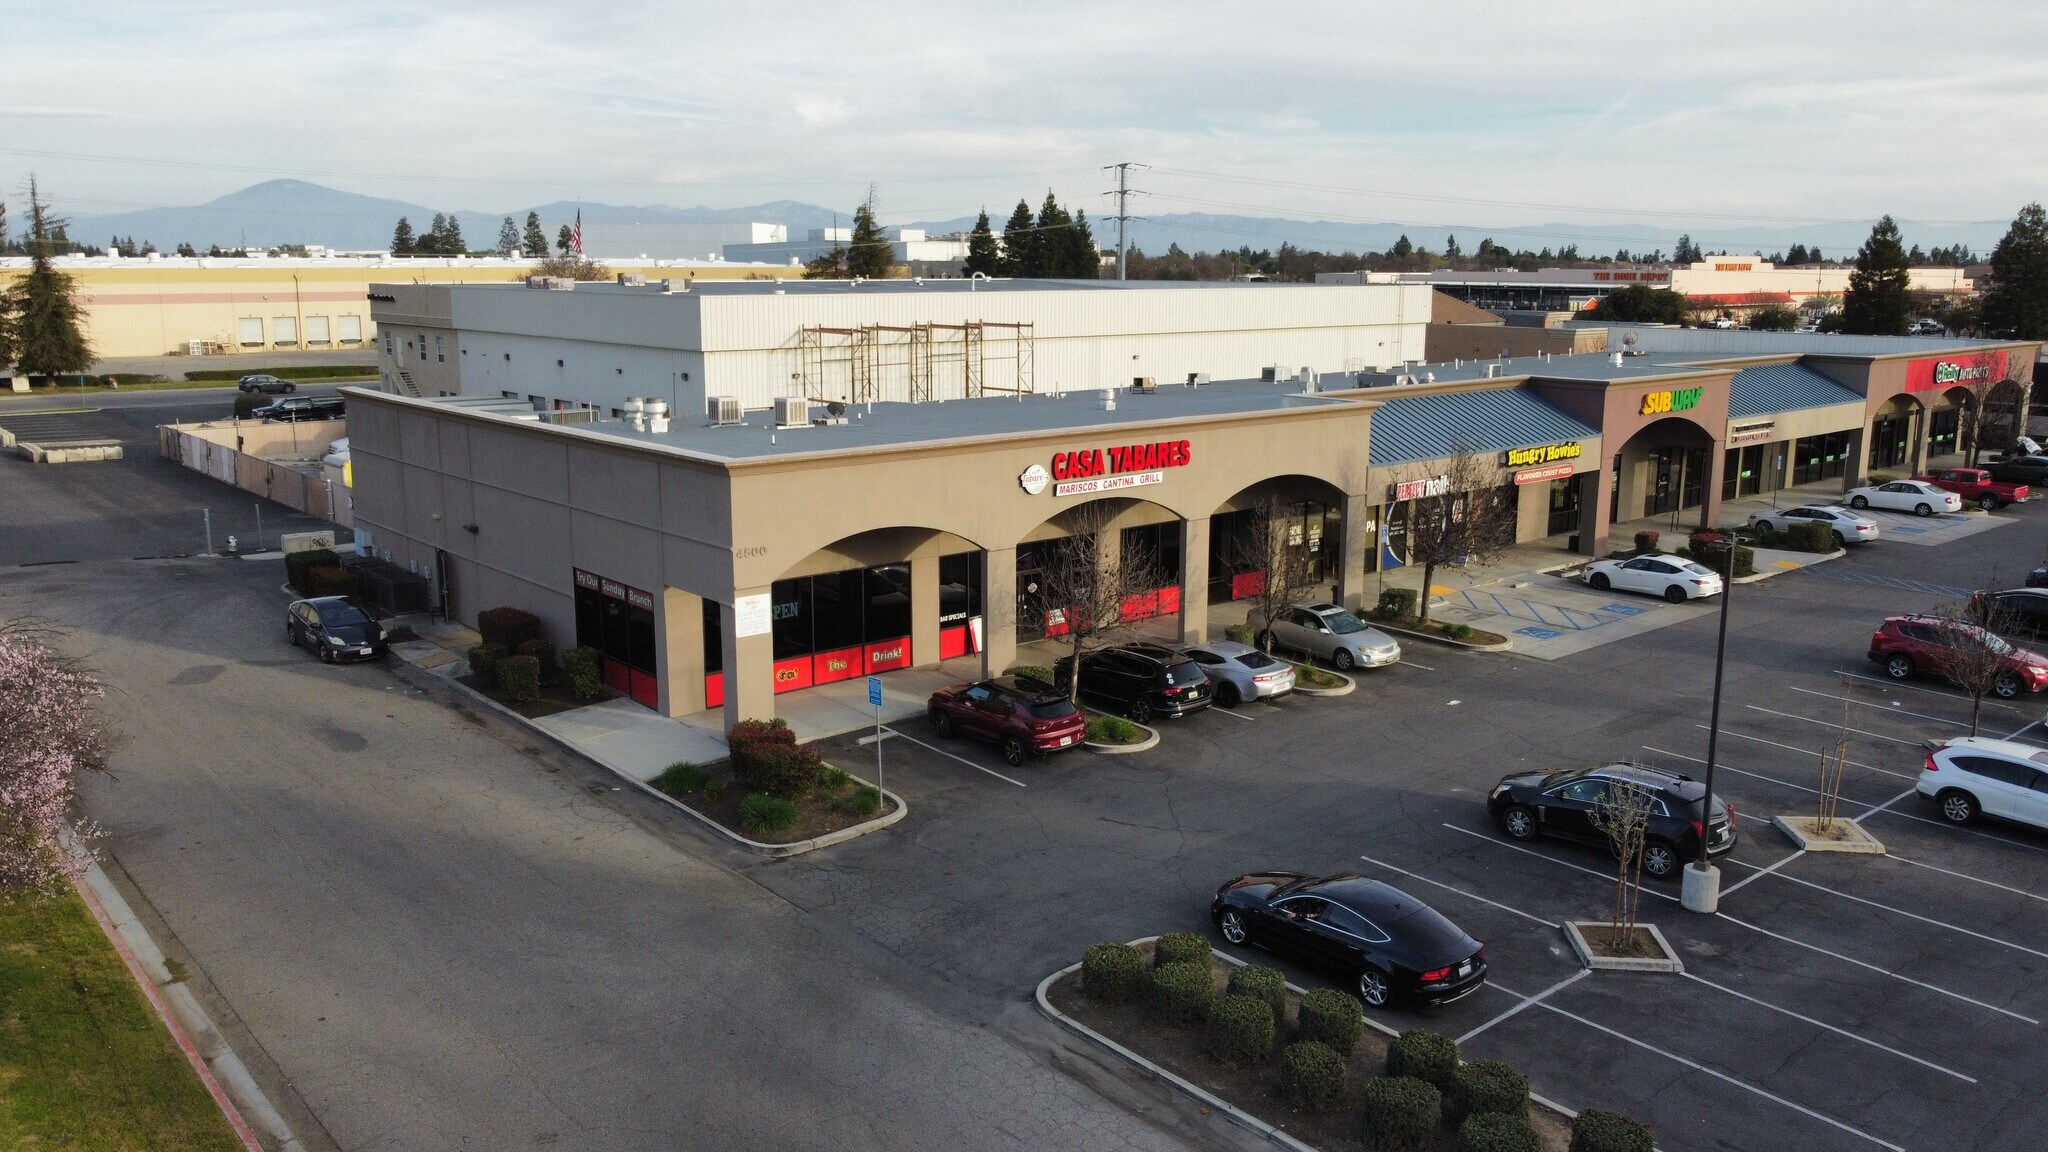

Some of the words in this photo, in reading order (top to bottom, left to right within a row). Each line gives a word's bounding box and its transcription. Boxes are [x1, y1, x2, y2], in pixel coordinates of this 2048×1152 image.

[1642, 386, 1704, 415] SUBWAY
[1053, 449, 1105, 480] CASA
[1108, 440, 1191, 474] TABARES
[1508, 449, 1546, 465] Hungry
[1547, 442, 1580, 460] Howie's
[1517, 472, 1541, 481] FLAVORED
[1543, 469, 1558, 477] CRUST
[1558, 467, 1572, 475] PIZZA
[1059, 482, 1098, 494] MARISCOS
[1103, 477, 1134, 490] CANTINA
[1140, 474, 1160, 484] GRILL
[1397, 481, 1425, 500] PERFECT
[735, 546, 766, 558] 4500
[576, 571, 585, 584] Try
[587, 575, 598, 587] Out
[603, 580, 625, 598] Sunday
[629, 591, 652, 607] Brunch
[772, 602, 799, 619] PEN
[873, 647, 902, 663] Drink!
